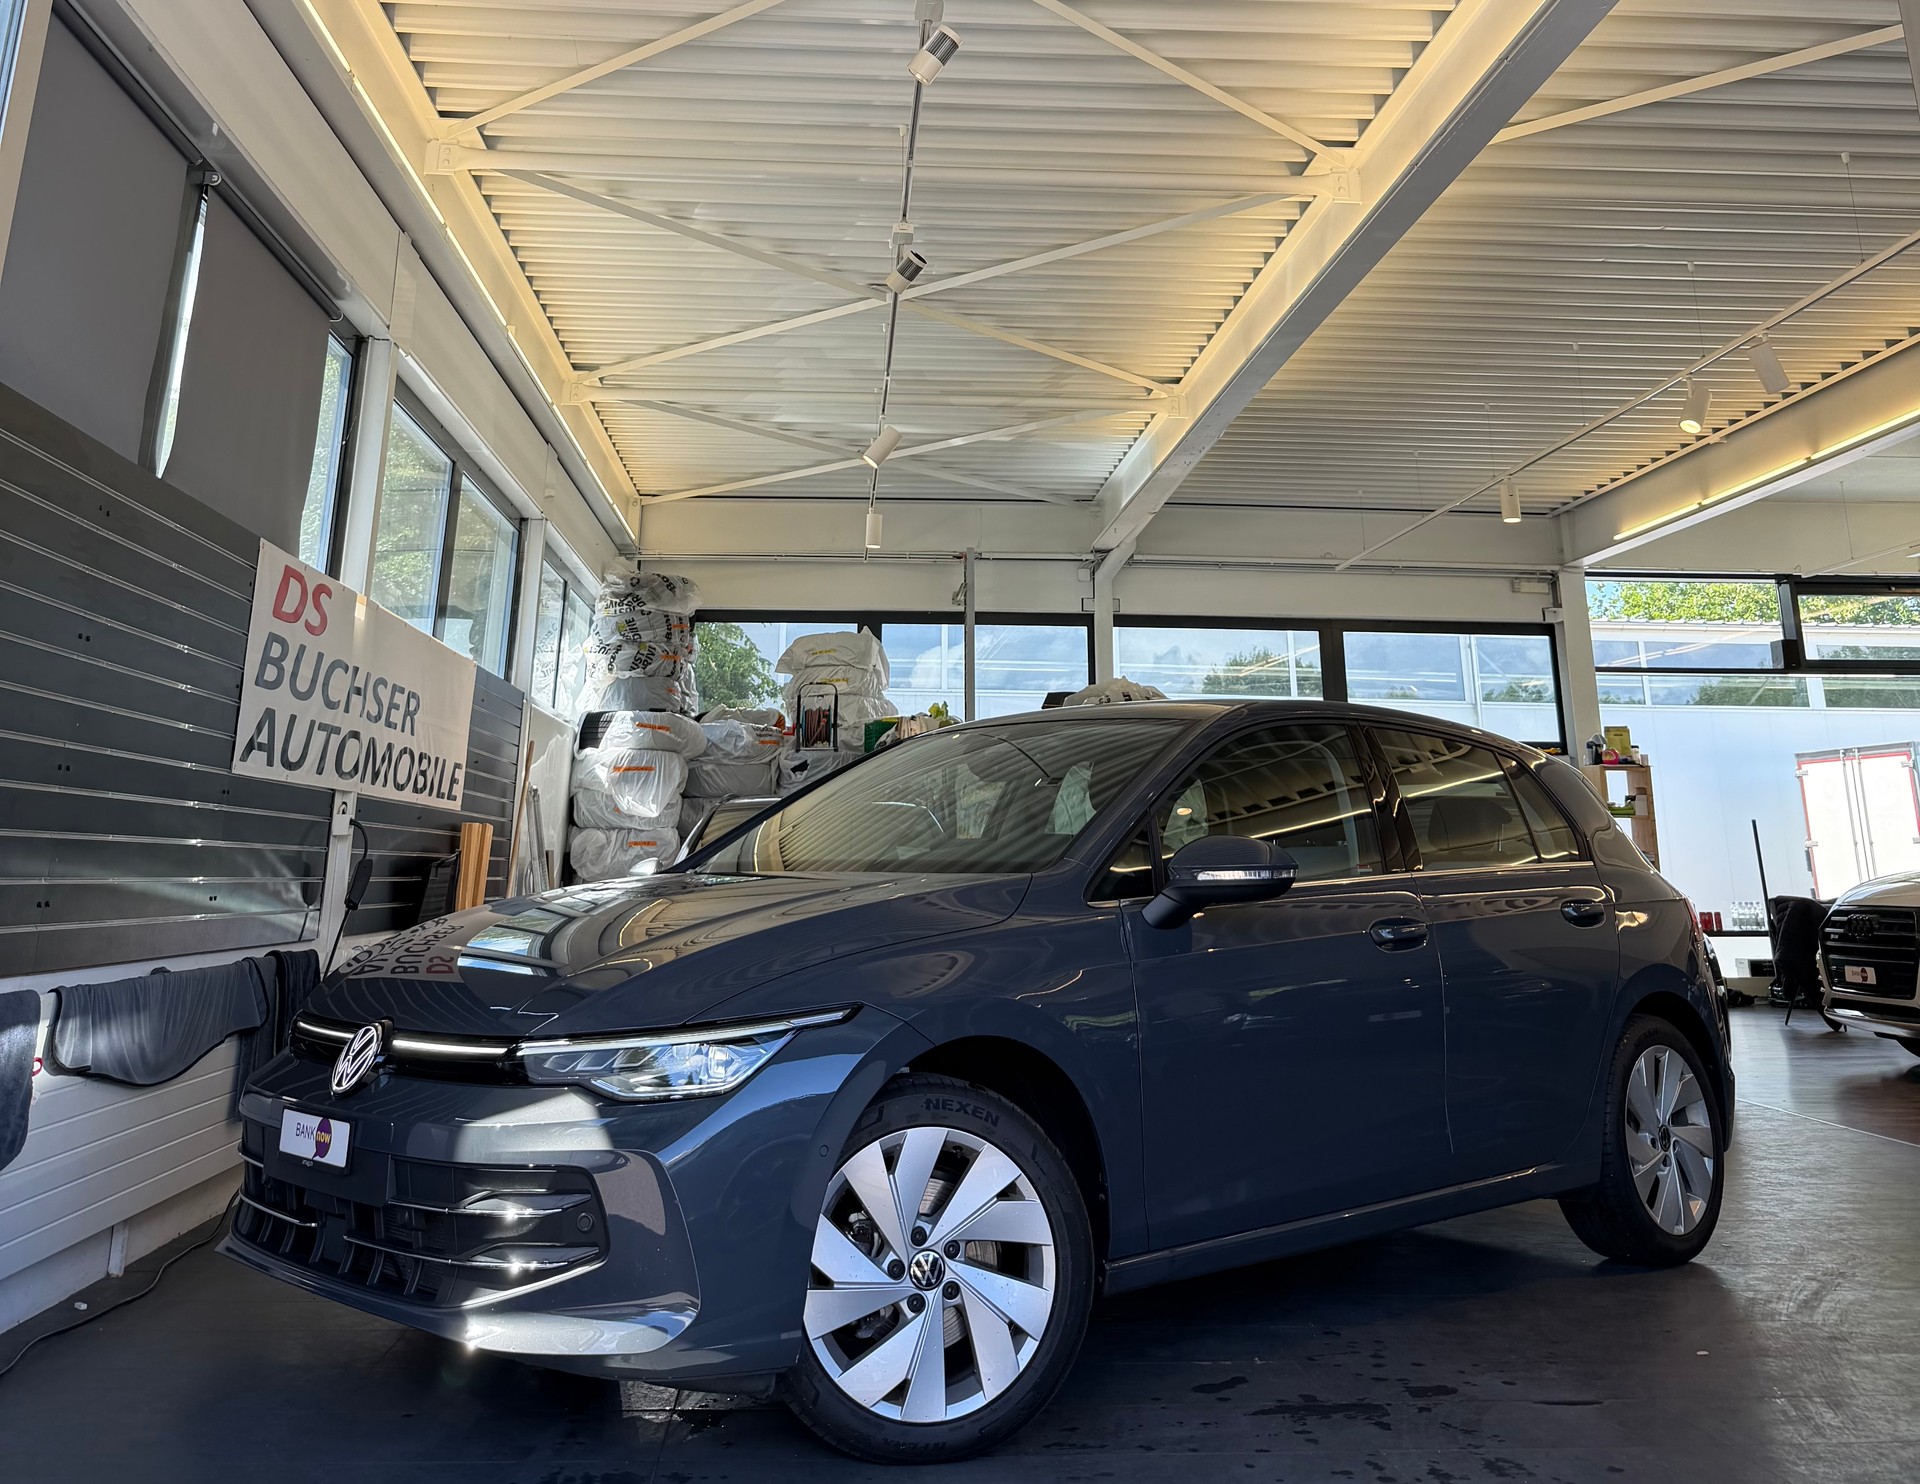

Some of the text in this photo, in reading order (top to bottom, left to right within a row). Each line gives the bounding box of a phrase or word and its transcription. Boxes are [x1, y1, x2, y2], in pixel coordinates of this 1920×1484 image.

[272, 564, 333, 637] DS
[254, 631, 421, 737] BUCHSER
[239, 707, 464, 802] AUTOMOBILE
[295, 1122, 332, 1144] BANK now
[924, 1097, 1000, 1127] NEXEN
